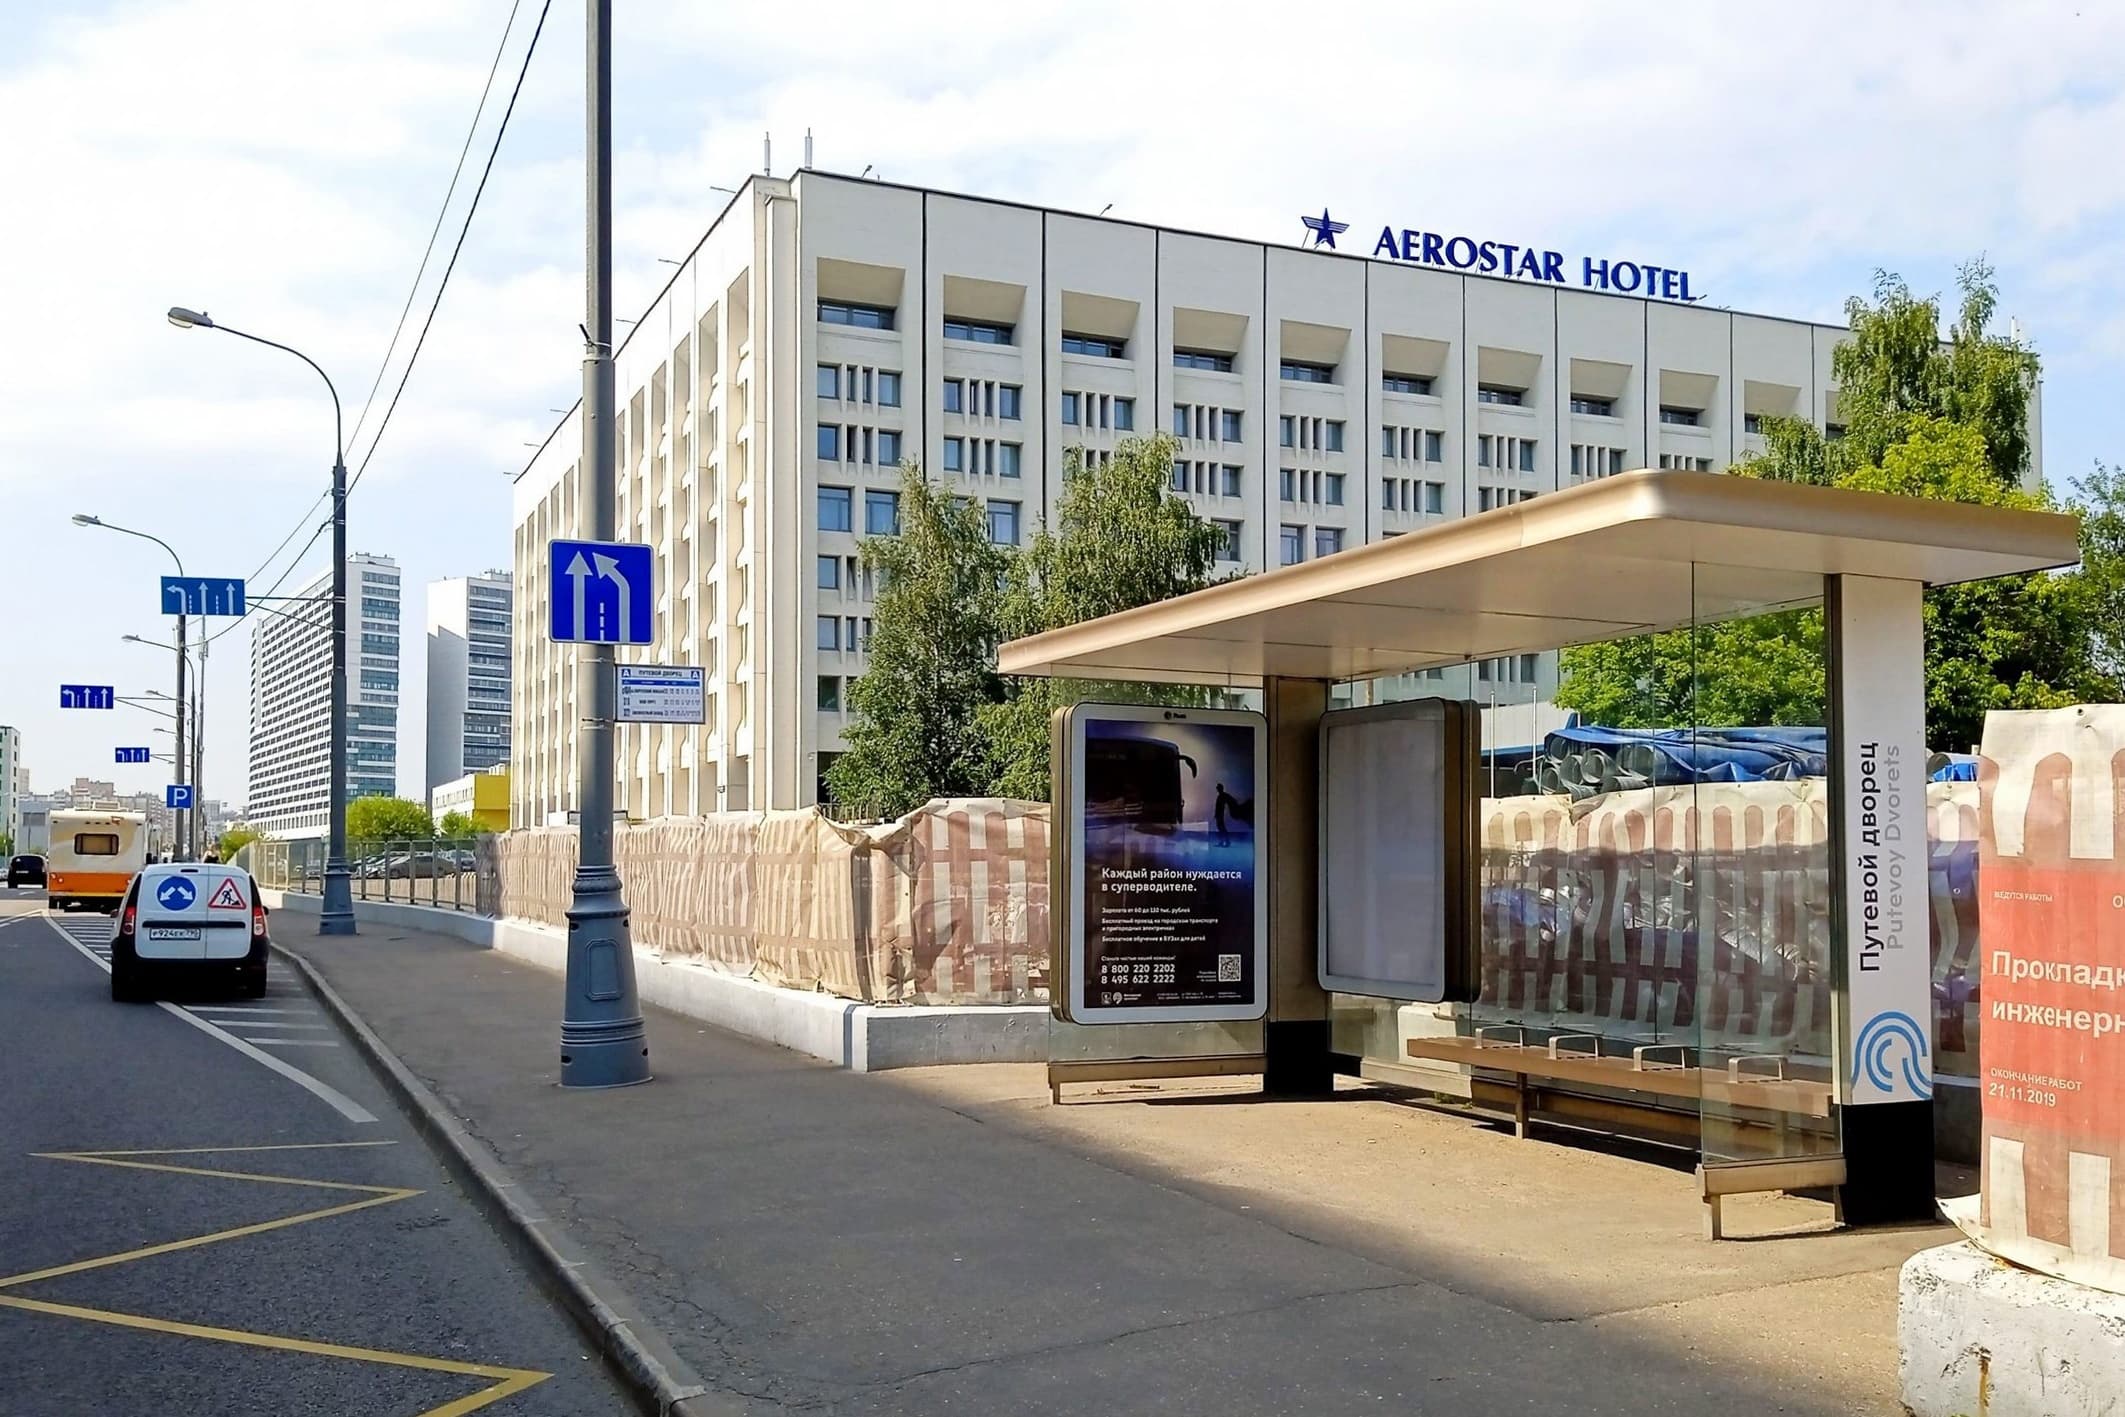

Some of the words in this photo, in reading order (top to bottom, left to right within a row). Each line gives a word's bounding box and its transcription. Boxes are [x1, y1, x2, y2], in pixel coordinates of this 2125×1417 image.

[1373, 226, 1565, 282] AEROSTAR
[1583, 256, 1698, 301] HOTEL
[173, 787, 188, 806] P
[1861, 742, 1881, 847] дворец
[1884, 745, 1901, 841] Dvorets
[1102, 868, 1148, 880] Каждый
[1150, 868, 1183, 880] район
[1185, 870, 1242, 880] нуждается
[1101, 883, 1108, 892] в
[1111, 882, 1197, 894] суперводителе.
[1887, 849, 1906, 949] Putevoy
[1858, 855, 1884, 971] Путевой
[1101, 964, 1108, 974] 8
[1111, 964, 1129, 974] 800
[1133, 963, 1150, 973] 220
[1153, 963, 1176, 973] 2202
[1101, 975, 1108, 984] 8
[1111, 975, 1129, 984] 495
[1132, 974, 1150, 984] 622
[1153, 974, 1175, 984] 2222
[1990, 1067, 2048, 1088] ОКОНЧАНИЕ
[2048, 1077, 2083, 1092] РАБОТ
[1988, 1082, 2056, 1107] 21.11.2019
